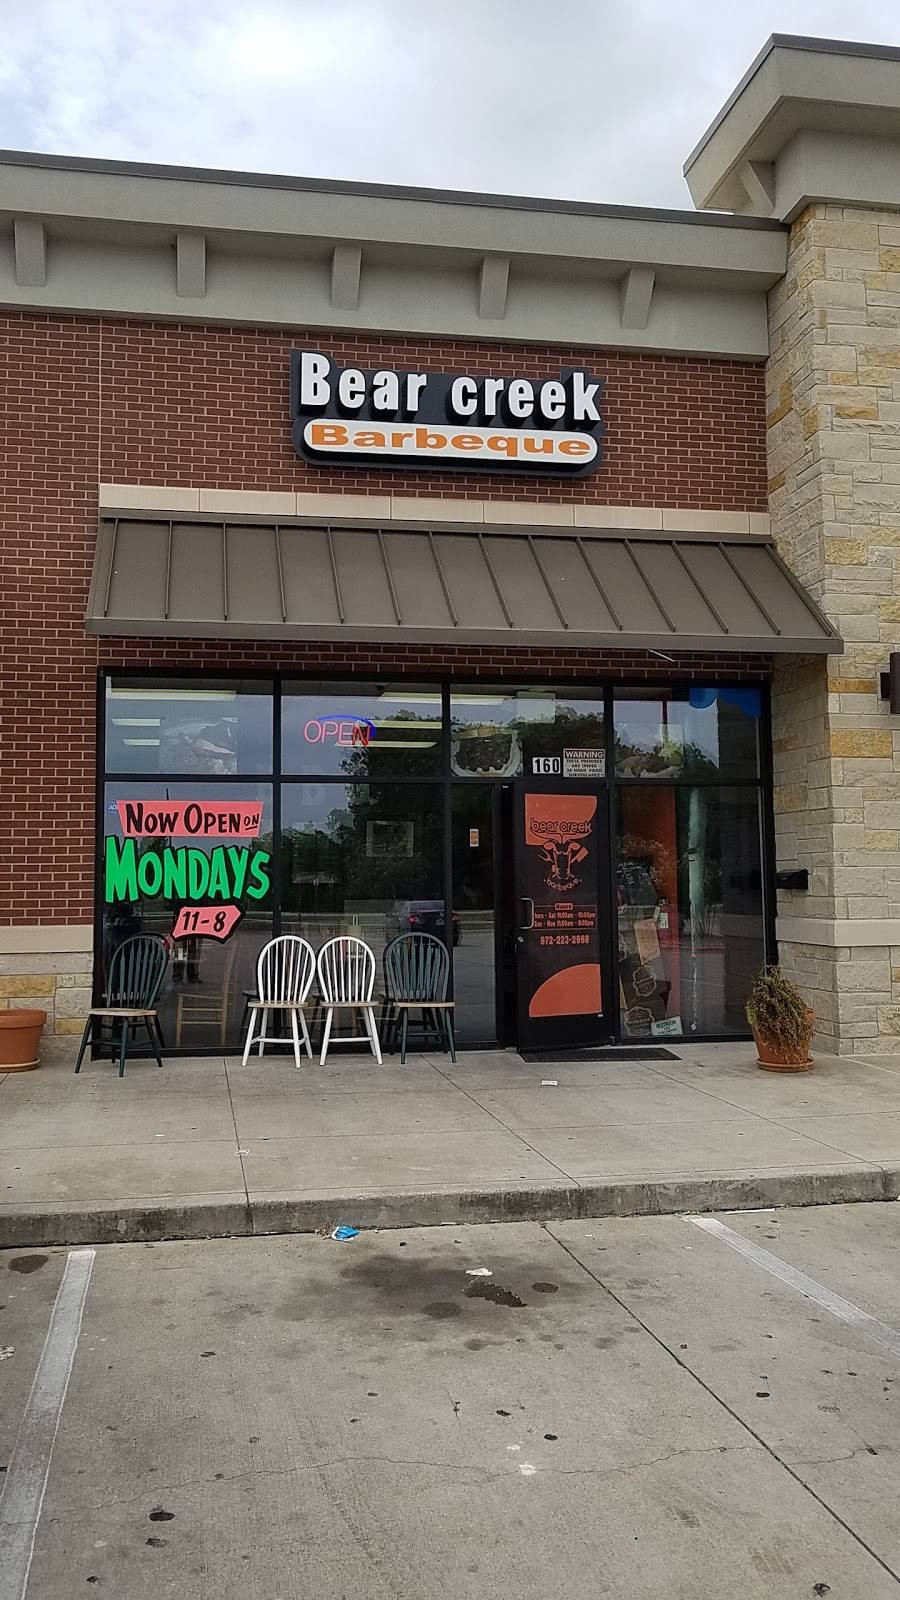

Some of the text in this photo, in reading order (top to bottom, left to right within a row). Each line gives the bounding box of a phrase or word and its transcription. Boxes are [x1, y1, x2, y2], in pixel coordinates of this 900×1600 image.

[300, 352, 601, 421] Bear creek
[311, 424, 591, 457] Barbeque
[304, 720, 371, 746] OPEN
[534, 758, 560, 773] 160
[565, 751, 604, 759] WARNING
[530, 818, 592, 832] bear creek
[182, 911, 227, 932] 11-8
